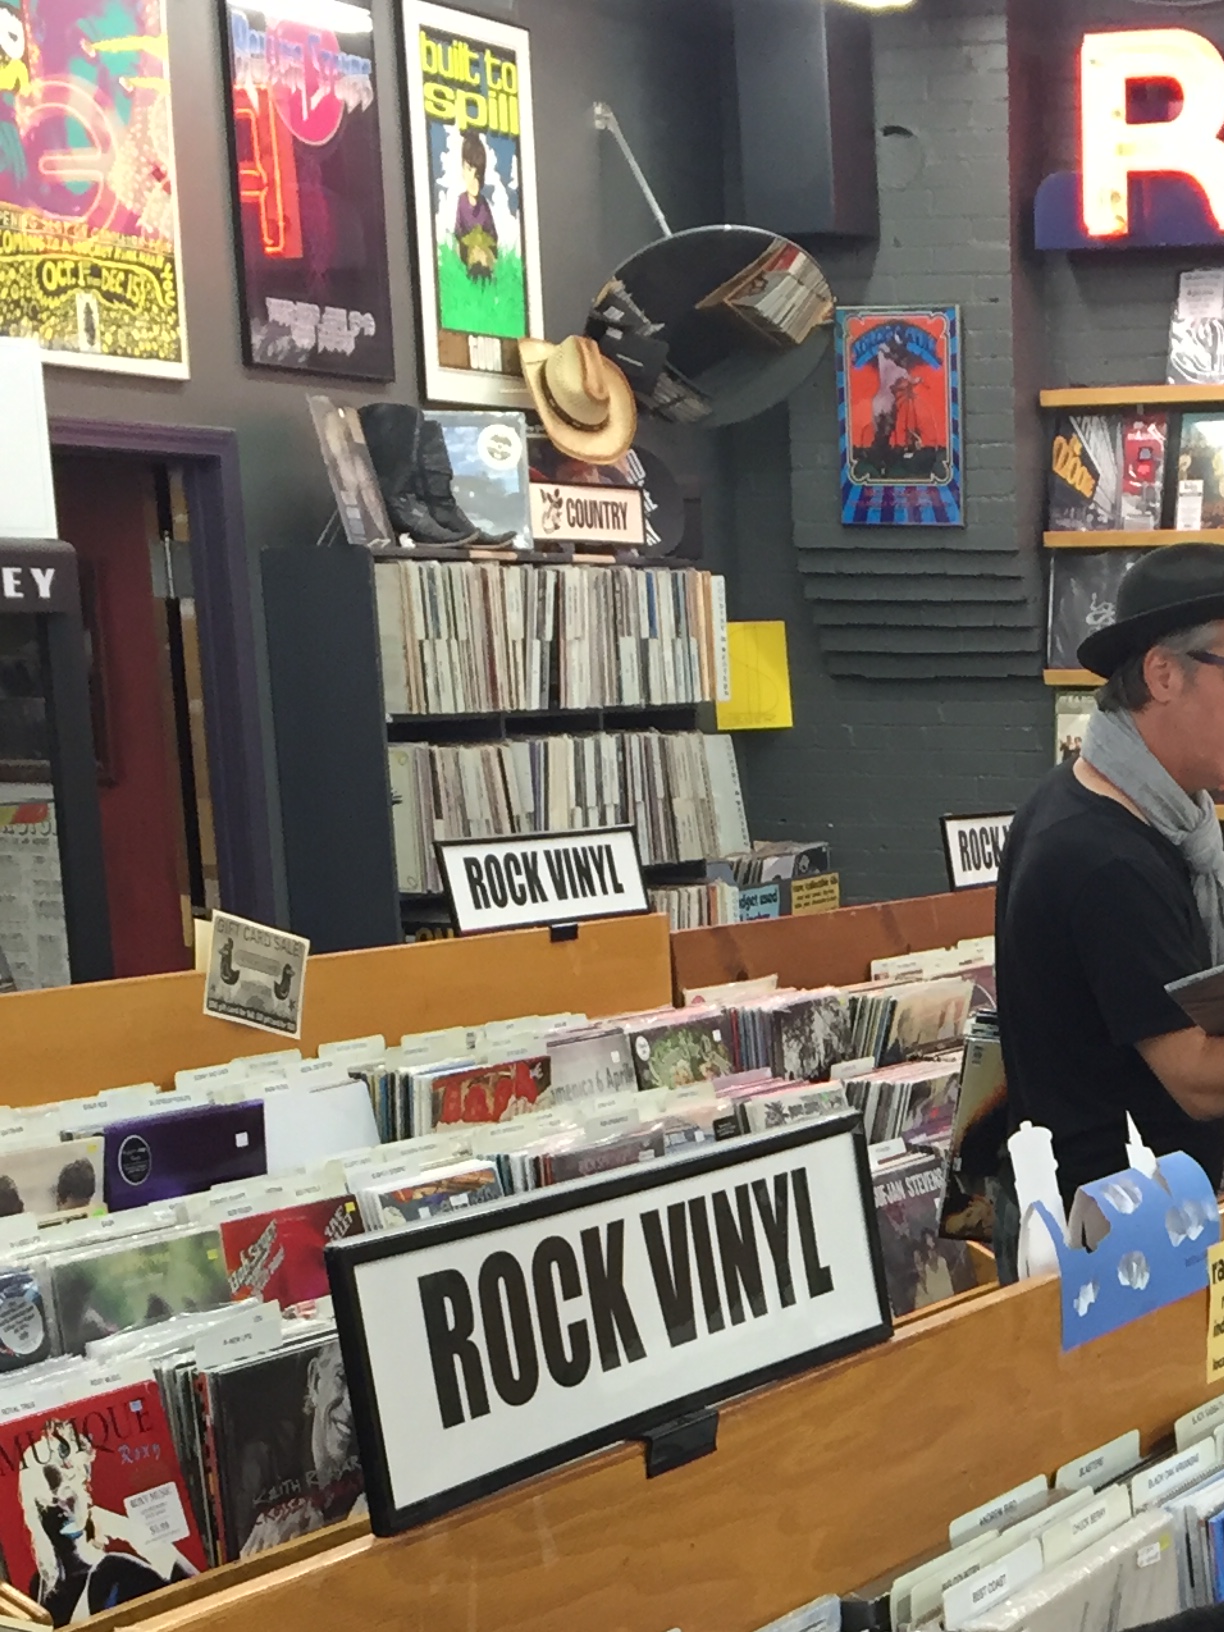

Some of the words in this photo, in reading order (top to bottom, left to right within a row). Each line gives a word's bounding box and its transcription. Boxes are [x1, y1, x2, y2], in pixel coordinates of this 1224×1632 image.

[420, 31, 480, 86] built
[484, 49, 517, 94] to
[423, 82, 519, 135] spill
[566, 498, 628, 530] COUNTRY
[464, 850, 542, 911] ROCK
[542, 843, 625, 901] VINYL
[957, 825, 1000, 873] ROCK
[417, 1218, 647, 1430] ROCK
[640, 1166, 835, 1348] VINYL
